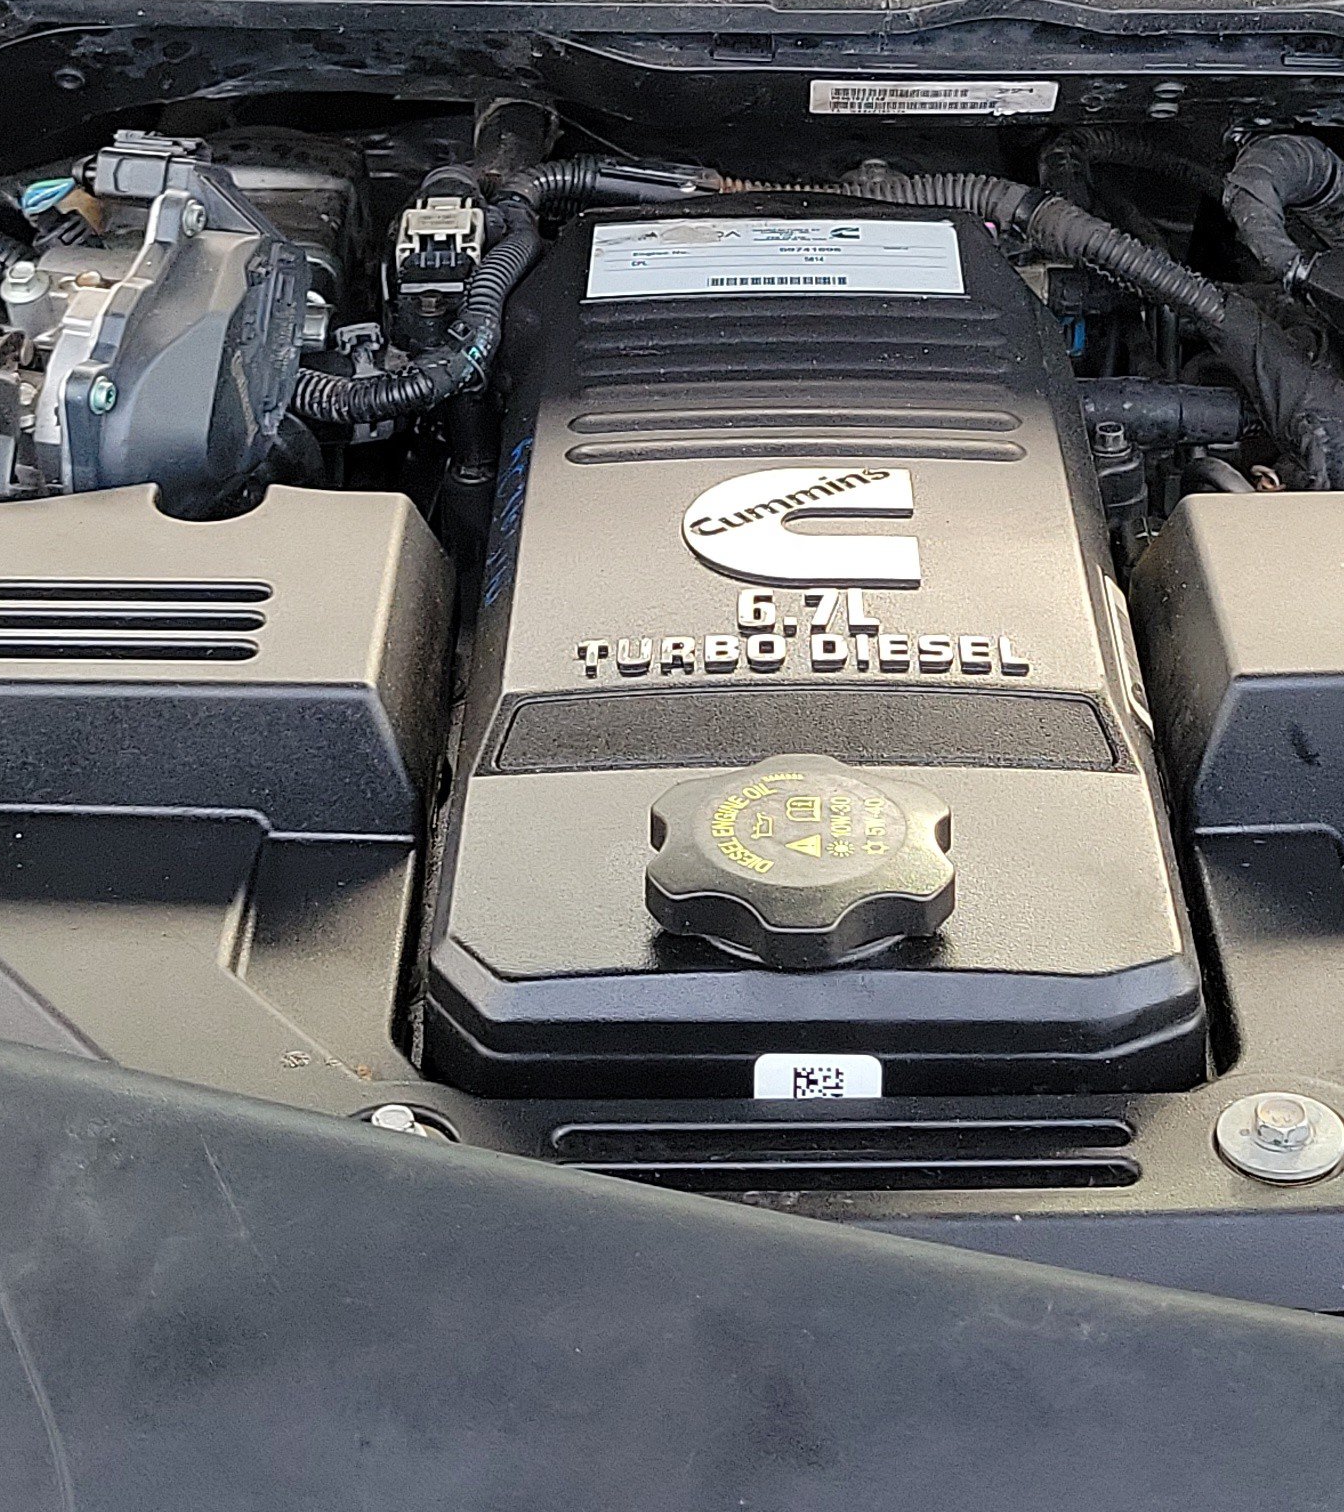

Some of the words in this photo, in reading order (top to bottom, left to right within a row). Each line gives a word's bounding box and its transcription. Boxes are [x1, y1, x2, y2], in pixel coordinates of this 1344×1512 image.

[689, 467, 891, 537] Cummins
[737, 587, 881, 637] 6.7L
[576, 633, 786, 678] TURBO
[810, 632, 1031, 676] DIESEL
[742, 782, 779, 801] OIL
[712, 794, 750, 837] ENGINE
[830, 795, 852, 838] 10W-30
[864, 796, 887, 837] 5W-40
[717, 836, 775, 874] DIESEL
